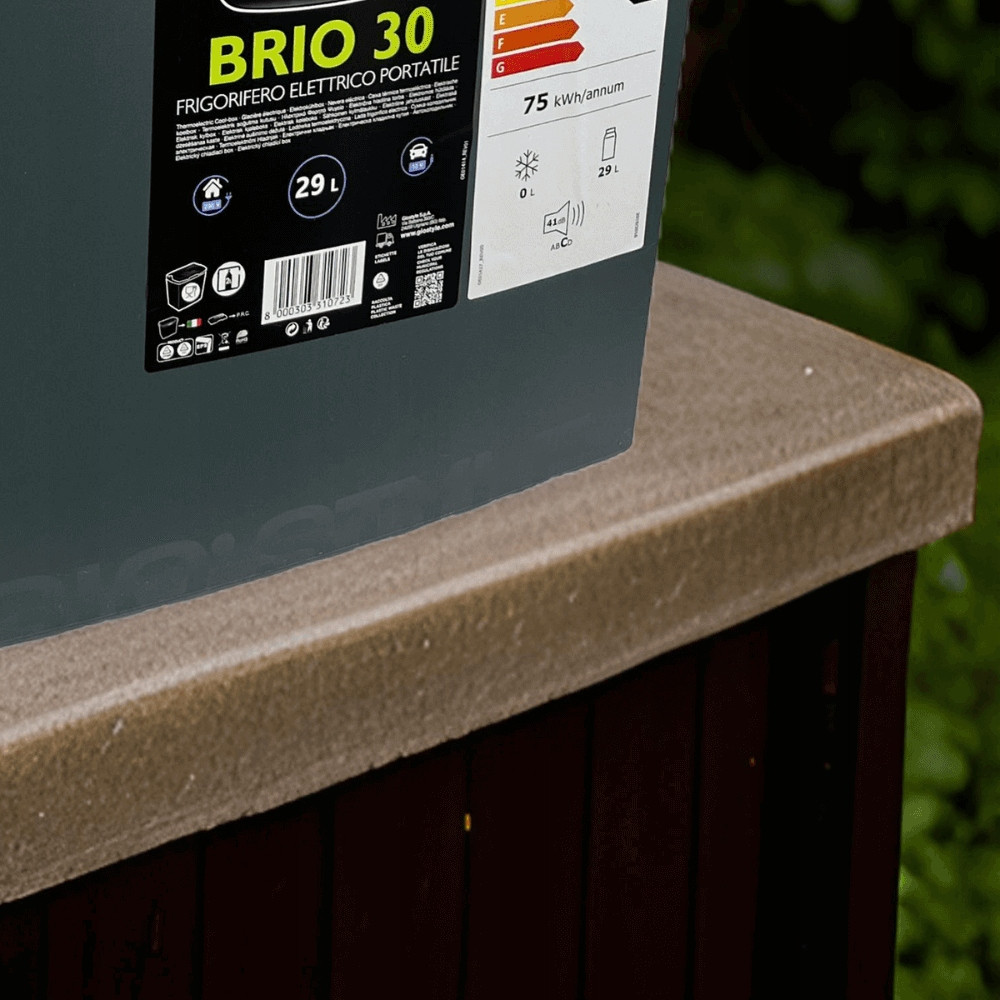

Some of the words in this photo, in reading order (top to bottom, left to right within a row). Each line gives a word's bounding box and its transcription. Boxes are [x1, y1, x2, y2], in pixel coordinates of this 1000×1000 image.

[499, 14, 506, 25] E
[209, 19, 356, 86] BRIO
[374, 6, 434, 60] 30
[497, 38, 504, 50] F
[496, 62, 505, 73] G
[176, 85, 285, 116] FRIGORIFERO
[290, 70, 376, 99] ELETTRICO
[380, 55, 460, 83] PORTATILE
[523, 93, 549, 115] 75
[554, 81, 625, 108] kWh/annum
[598, 165, 612, 178] 29
[614, 165, 619, 173] L
[295, 173, 325, 199] 29
[330, 178, 339, 192] L
[519, 188, 527, 198] 0
[530, 187, 535, 196] L
[546, 217, 558, 227] 41
[400, 222, 454, 238] www.giostyle.com
[264, 312, 271, 321] 8
[277, 303, 312, 318] 000303
[317, 295, 351, 309] 310723
